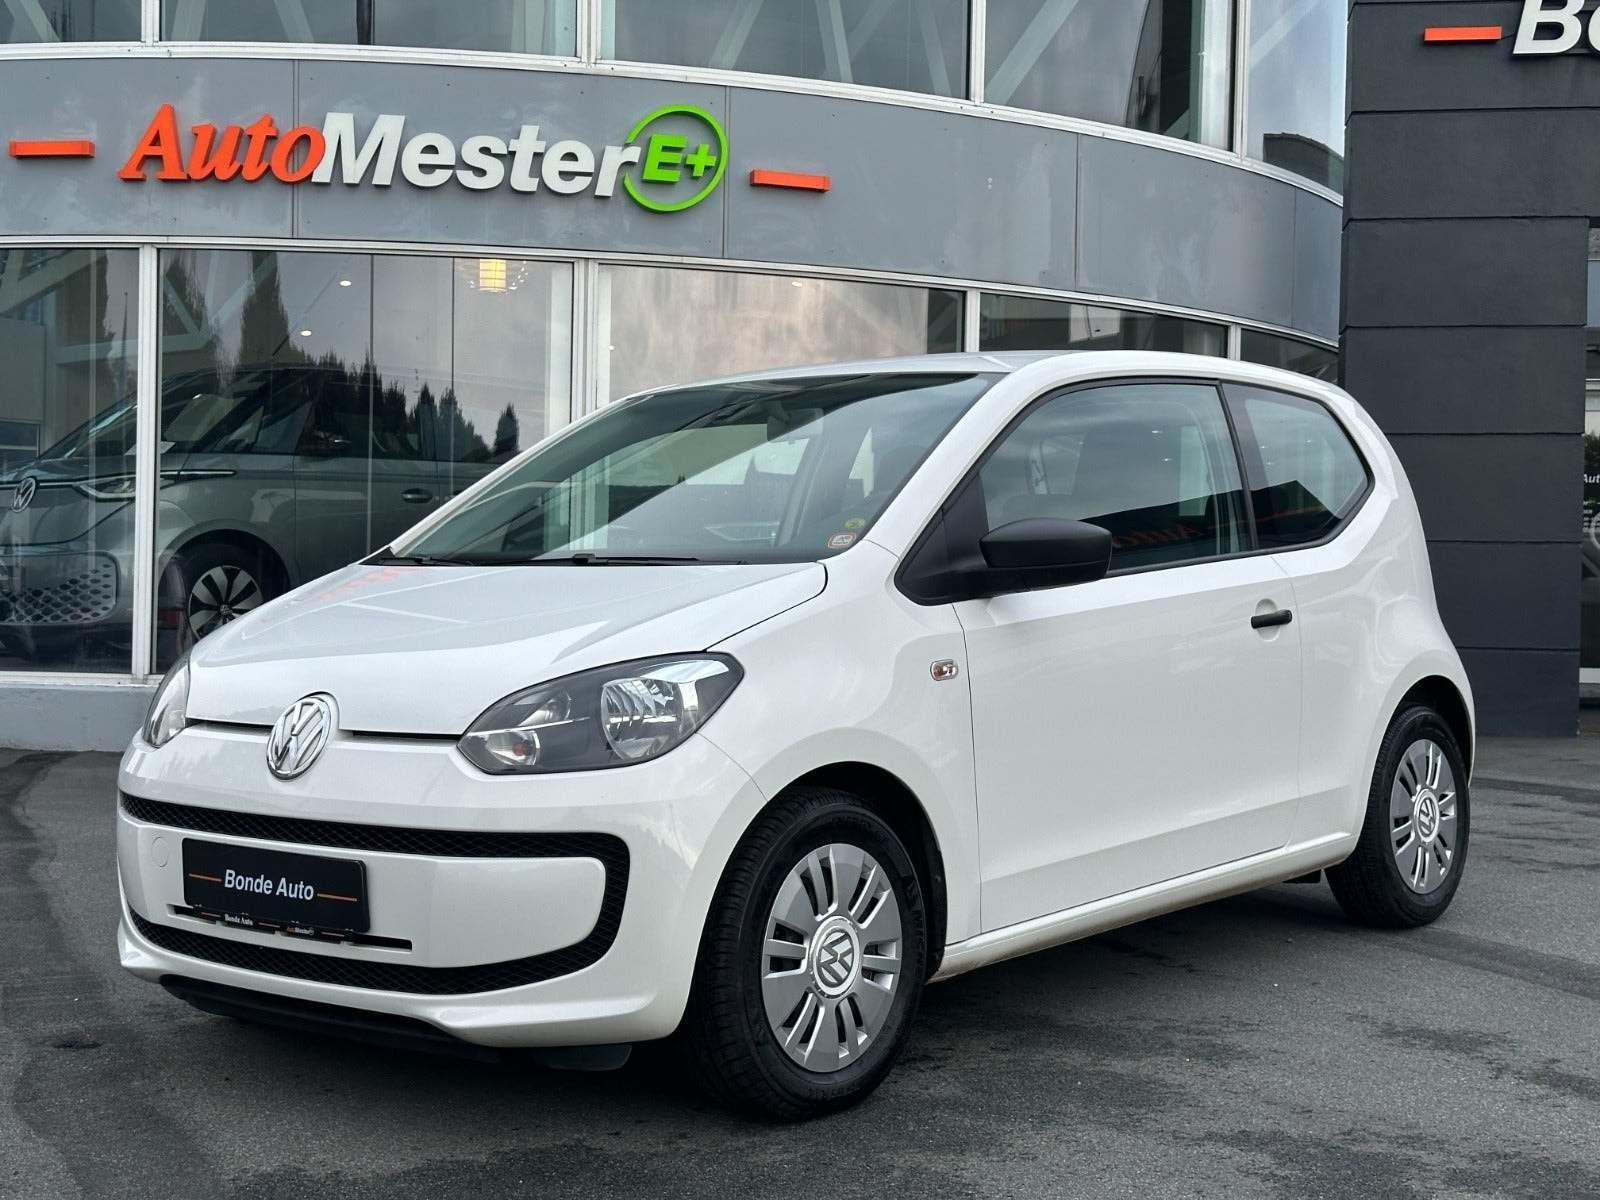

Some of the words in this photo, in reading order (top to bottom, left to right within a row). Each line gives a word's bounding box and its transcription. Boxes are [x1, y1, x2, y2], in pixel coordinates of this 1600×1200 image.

[1512, 0, 1600, 55] B
[224, 869, 273, 895] Bonde
[275, 877, 314, 900] Auto
